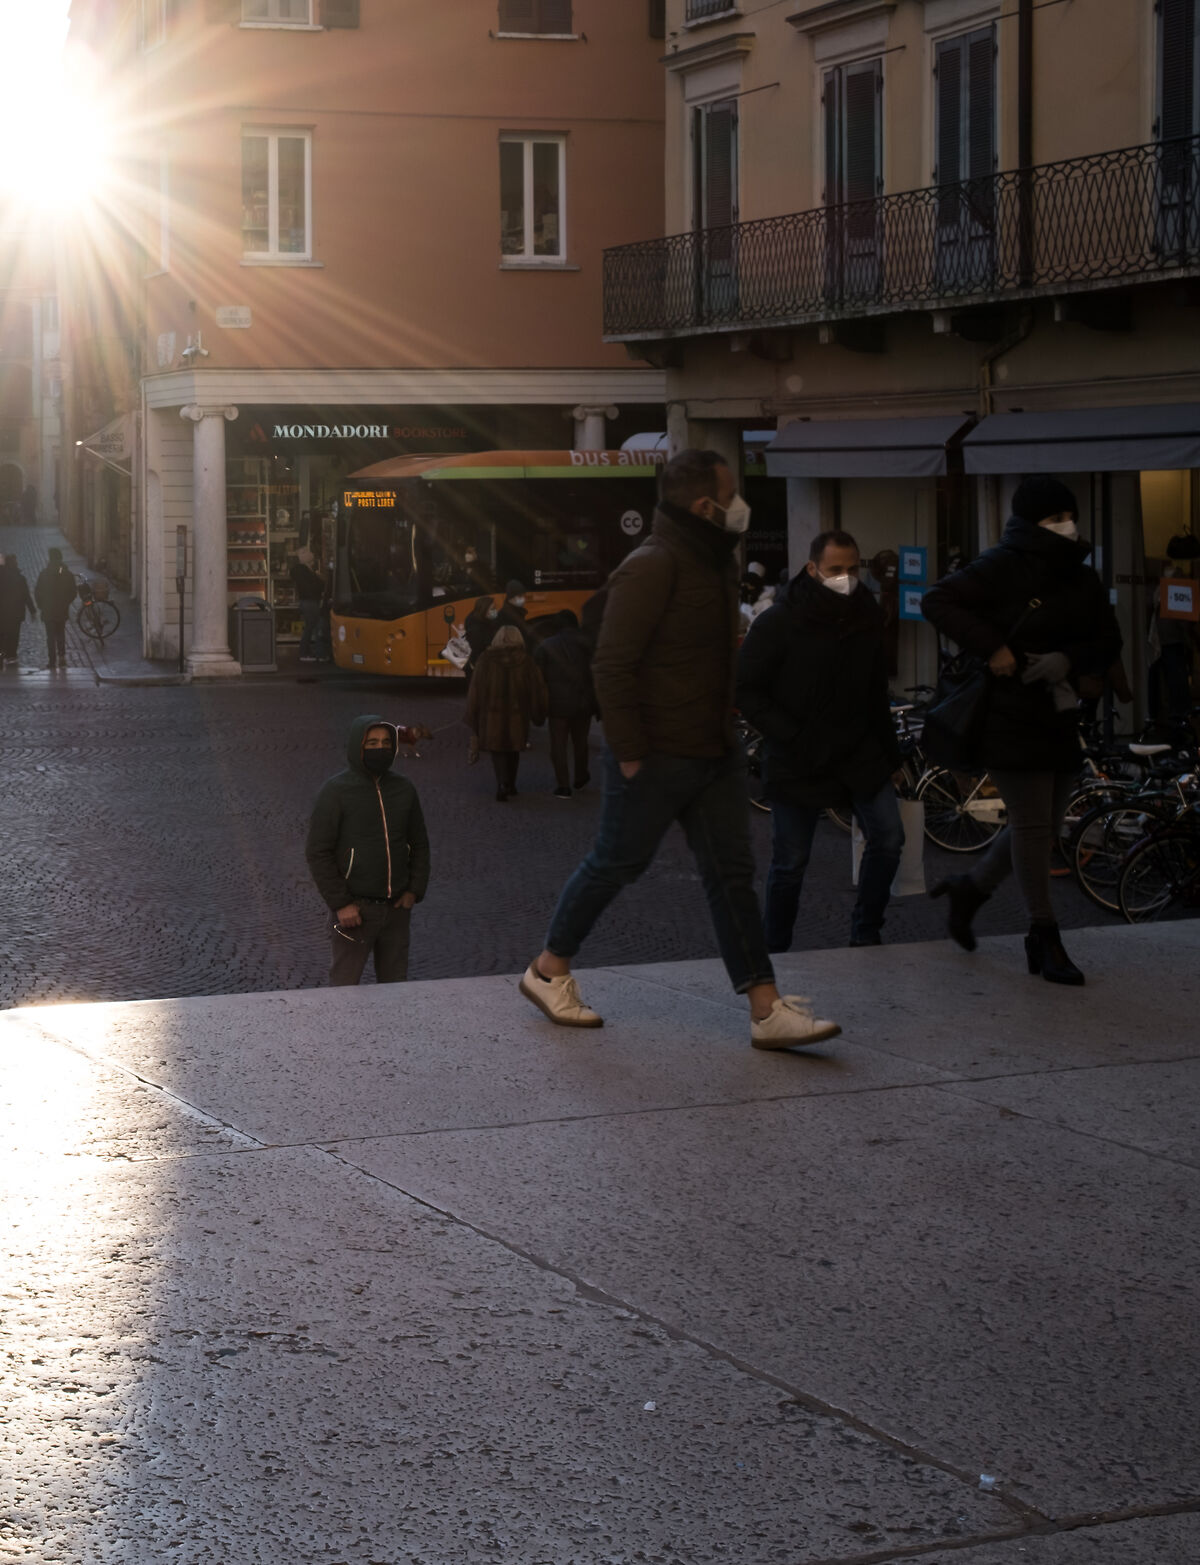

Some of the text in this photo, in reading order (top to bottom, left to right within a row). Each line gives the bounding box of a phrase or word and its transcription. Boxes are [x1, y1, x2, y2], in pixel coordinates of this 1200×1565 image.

[272, 424, 467, 438] MONDADORI BOOKSTORE
[568, 449, 610, 466] bus
[623, 517, 641, 528] CC
